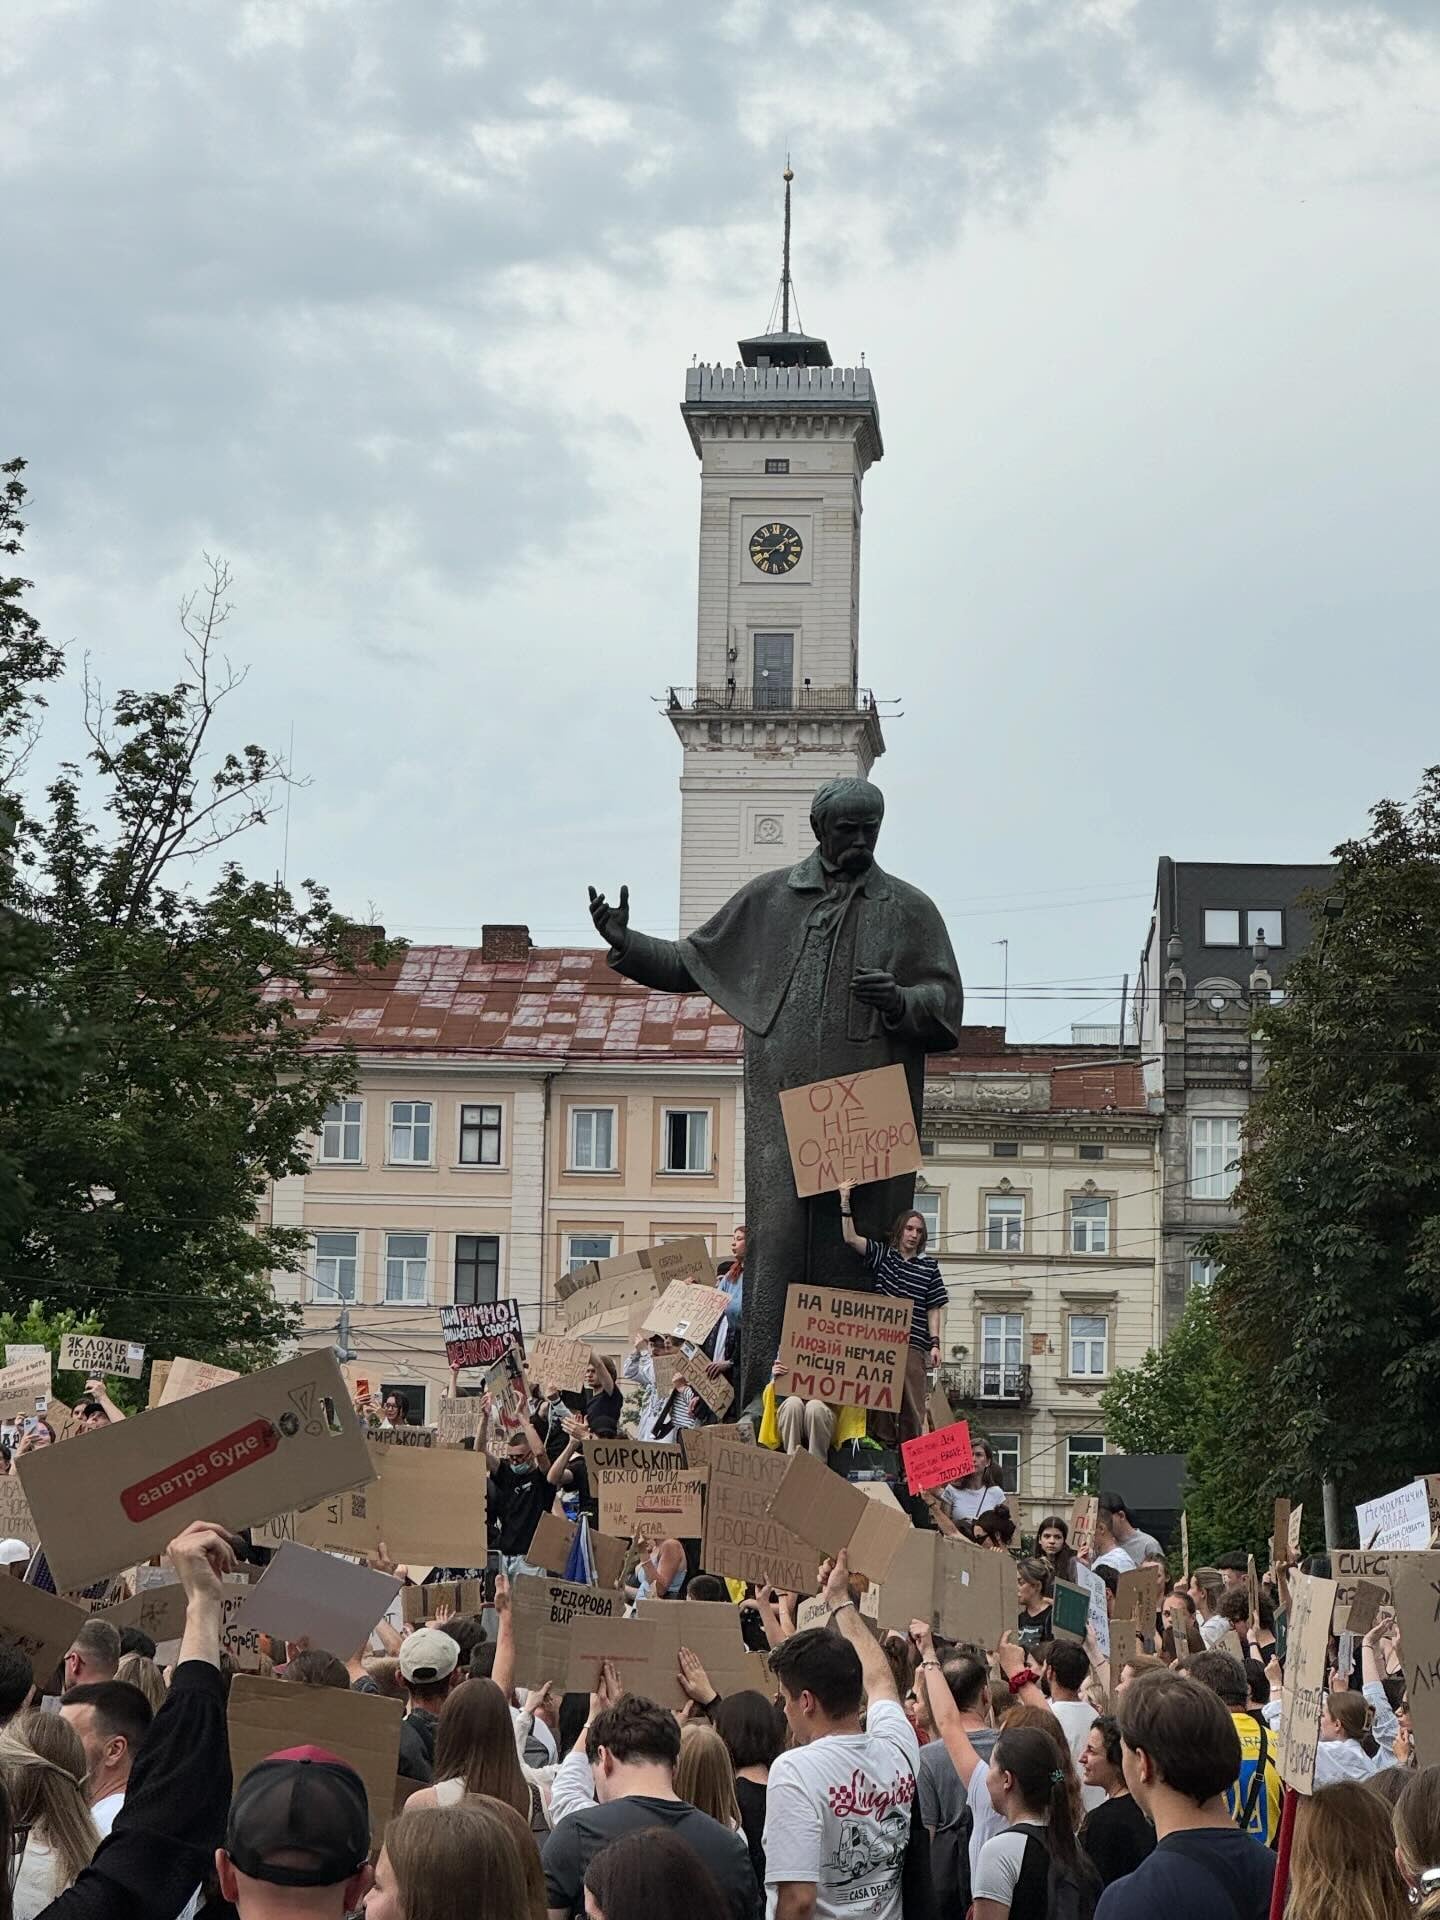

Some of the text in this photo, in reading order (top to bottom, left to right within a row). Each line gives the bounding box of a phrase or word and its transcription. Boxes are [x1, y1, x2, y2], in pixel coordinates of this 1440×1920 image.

[809, 1074, 862, 1112] ОХ
[823, 1107, 869, 1138] НЕ
[799, 1122, 916, 1167] ОДНАКОВО
[818, 1149, 890, 1190] МЕНІ
[797, 1292, 908, 1326] НА ЦВИНТАРІ
[67, 1336, 83, 1349] ЯК
[85, 1339, 127, 1355] ЛОХІВ
[807, 1316, 910, 1344] РОЗСТРІЛЯНИХ
[68, 1349, 127, 1365] РОЗВЕЛИ ЗА
[791, 1332, 896, 1366] ІЛЮЗІЙ НЕМАЄ
[72, 1358, 130, 1374] СПИНАМИ
[796, 1353, 893, 1384] МІСЦЯ ДЛЯ
[791, 1372, 892, 1408] МОГИЛ
[137, 1435, 259, 1507] завтра буде
[641, 1469, 678, 1483] ПРОТИ
[715, 1449, 786, 1482] ДЕМОКР
[645, 1481, 701, 1495] ДИКТАТУРИ
[714, 1545, 732, 1571] НЕ
[550, 1587, 612, 1617] ФЕДОРОВА
[835, 1769, 914, 1822] Luigi's
[850, 1887, 869, 1900] CASA
